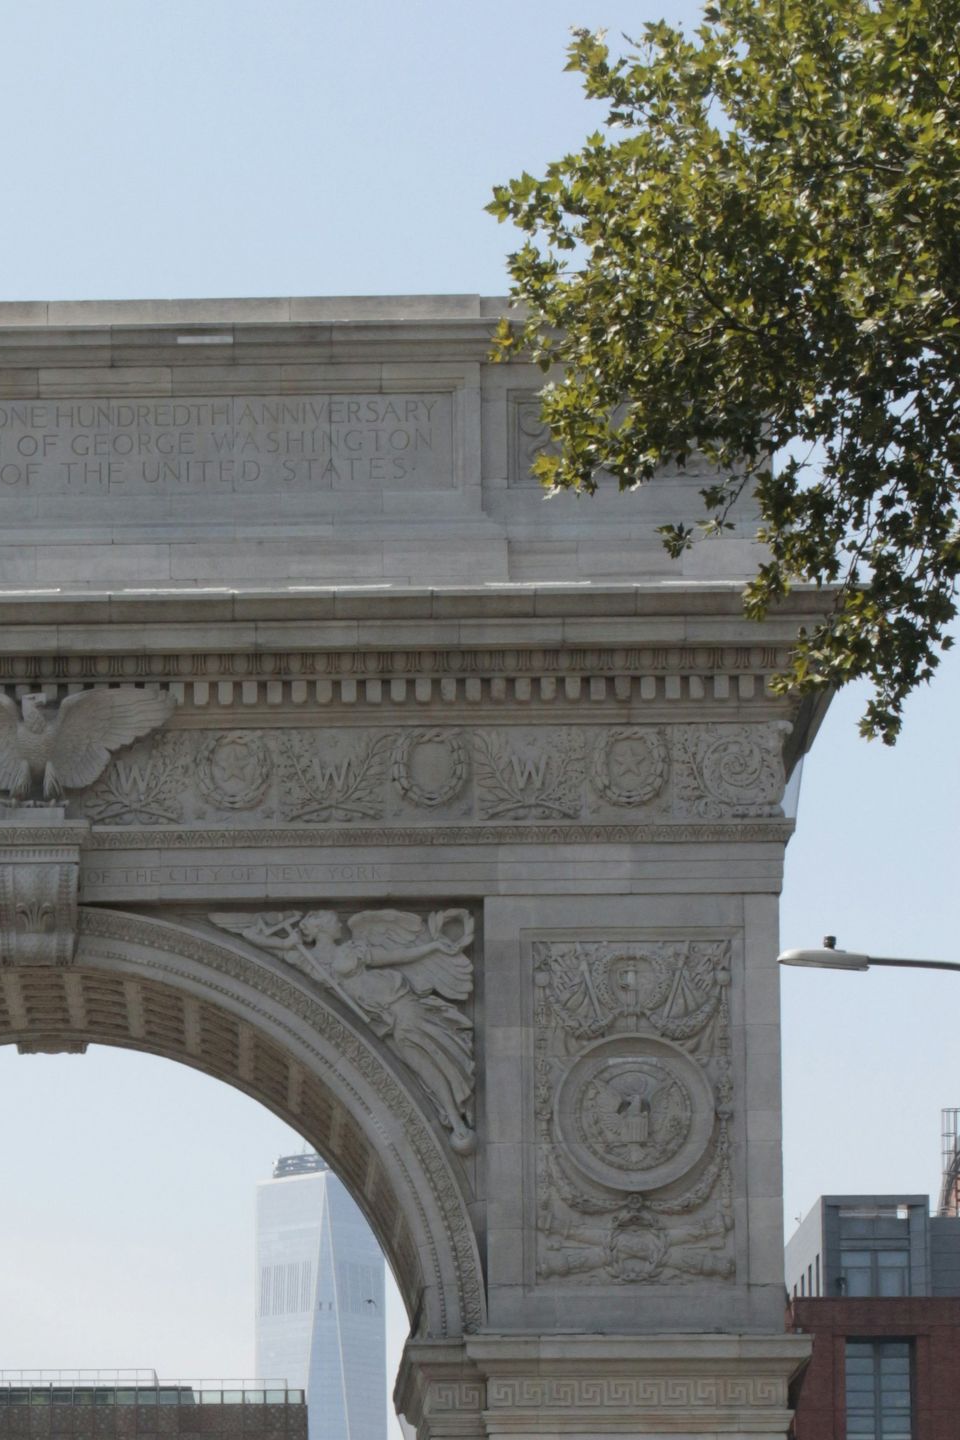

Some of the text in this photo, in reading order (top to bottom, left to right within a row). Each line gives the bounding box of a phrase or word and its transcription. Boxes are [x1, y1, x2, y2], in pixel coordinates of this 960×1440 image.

[55, 403, 231, 429] HUNDREDTH
[239, 400, 437, 426] ANNIVERSARY
[16, 434, 60, 458] OF
[71, 431, 195, 456] GEORGE
[211, 427, 433, 455] WASHINGTON
[0, 462, 42, 486] OF
[61, 461, 126, 484] THE
[141, 459, 261, 483] UNITED
